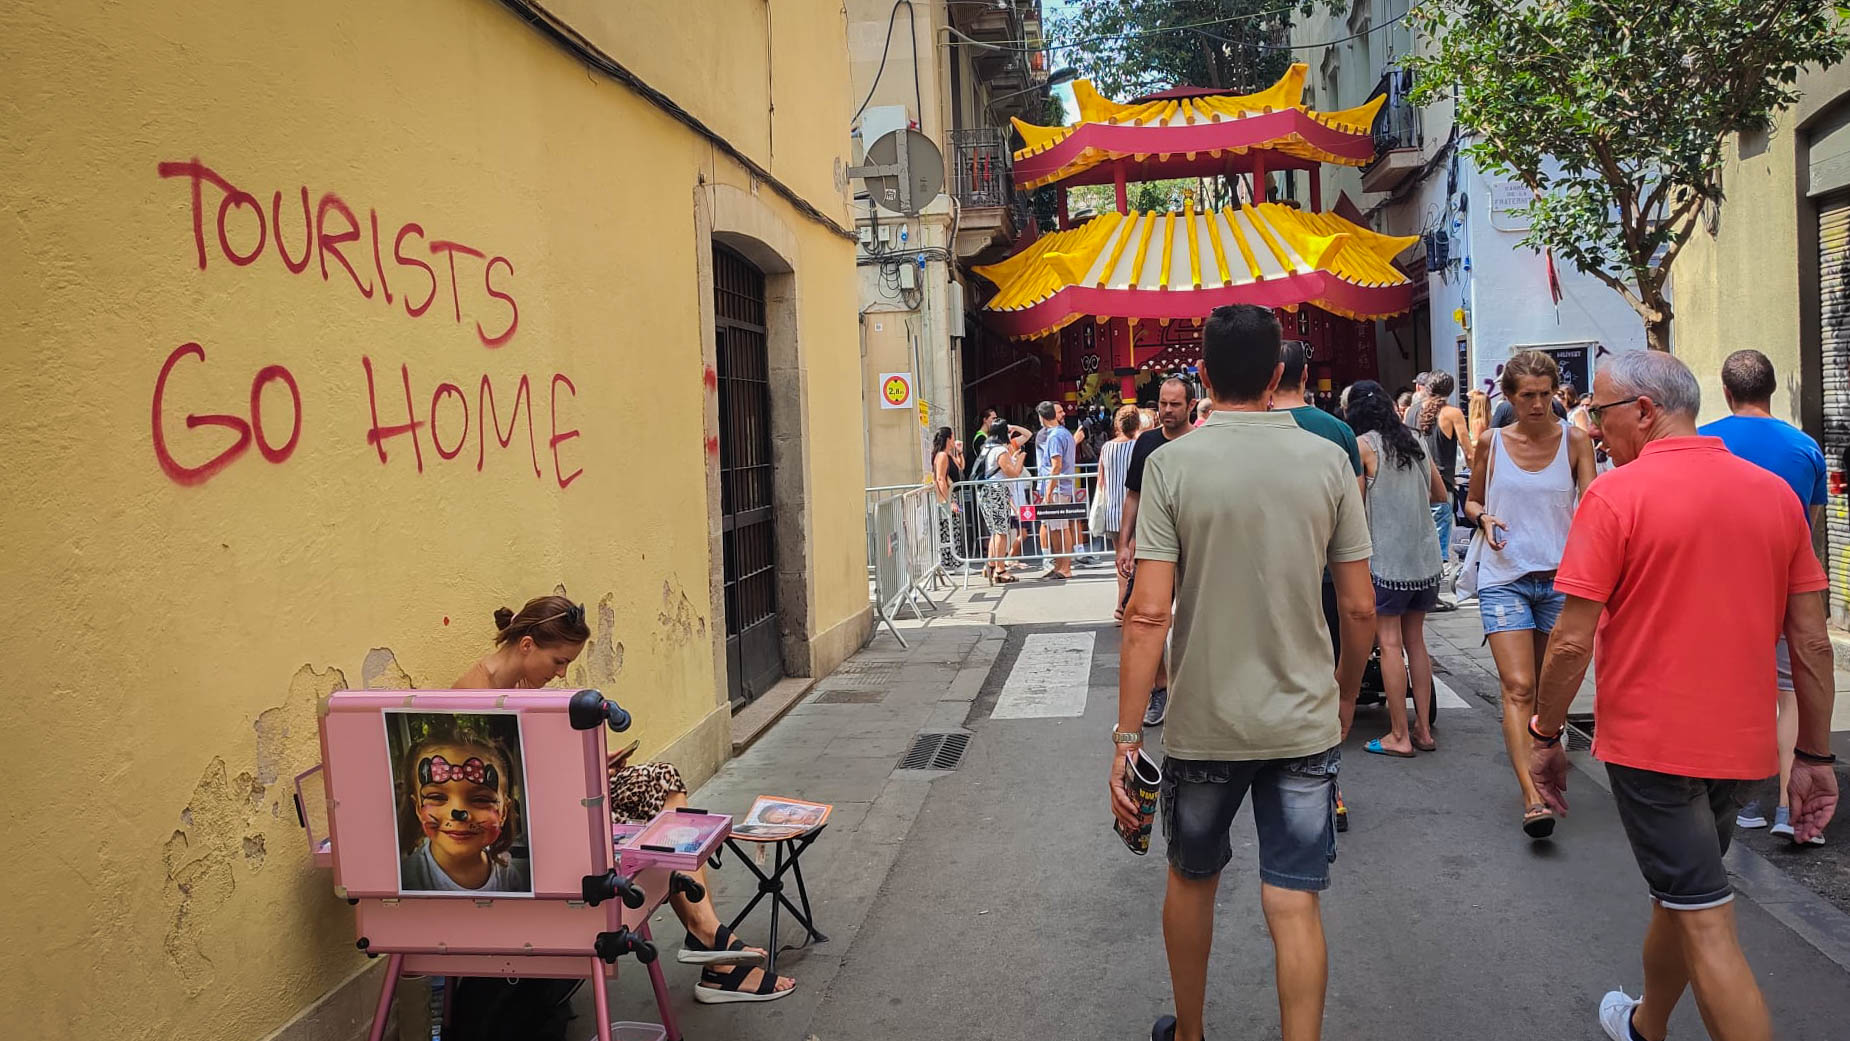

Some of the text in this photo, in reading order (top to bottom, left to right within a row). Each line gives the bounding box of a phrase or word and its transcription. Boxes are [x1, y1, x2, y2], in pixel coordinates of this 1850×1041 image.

[158, 159, 519, 349] TOURISTS
[151, 342, 584, 489] GO HOME
